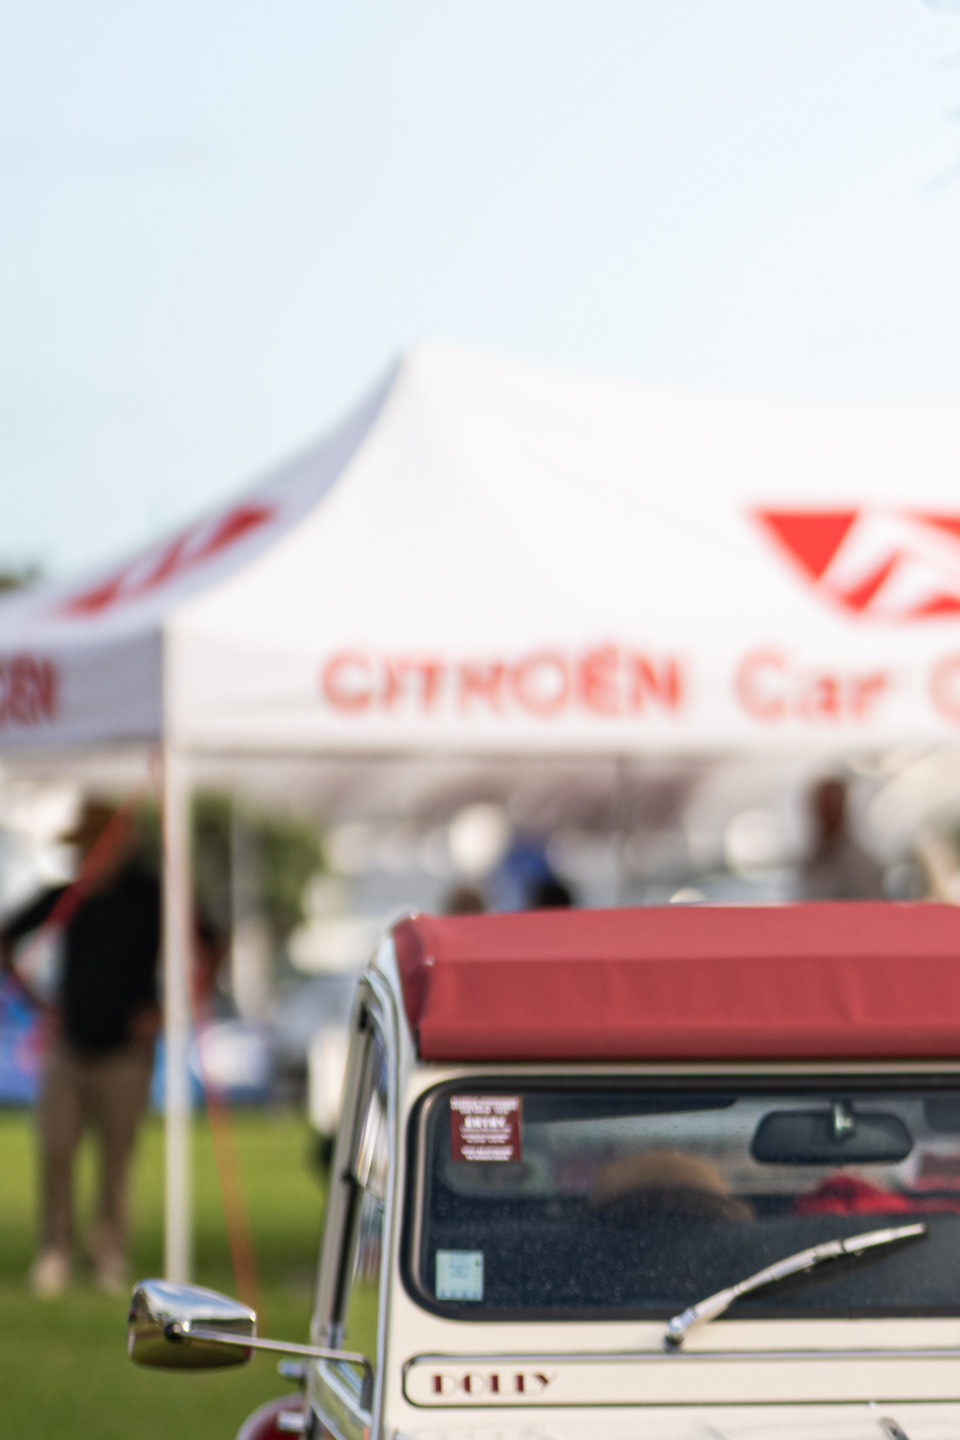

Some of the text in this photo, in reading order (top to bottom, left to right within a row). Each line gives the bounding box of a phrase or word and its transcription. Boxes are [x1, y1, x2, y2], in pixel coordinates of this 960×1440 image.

[321, 641, 685, 718] CITROËN
[735, 650, 888, 725] Car
[431, 1371, 559, 1397] DOLLY
